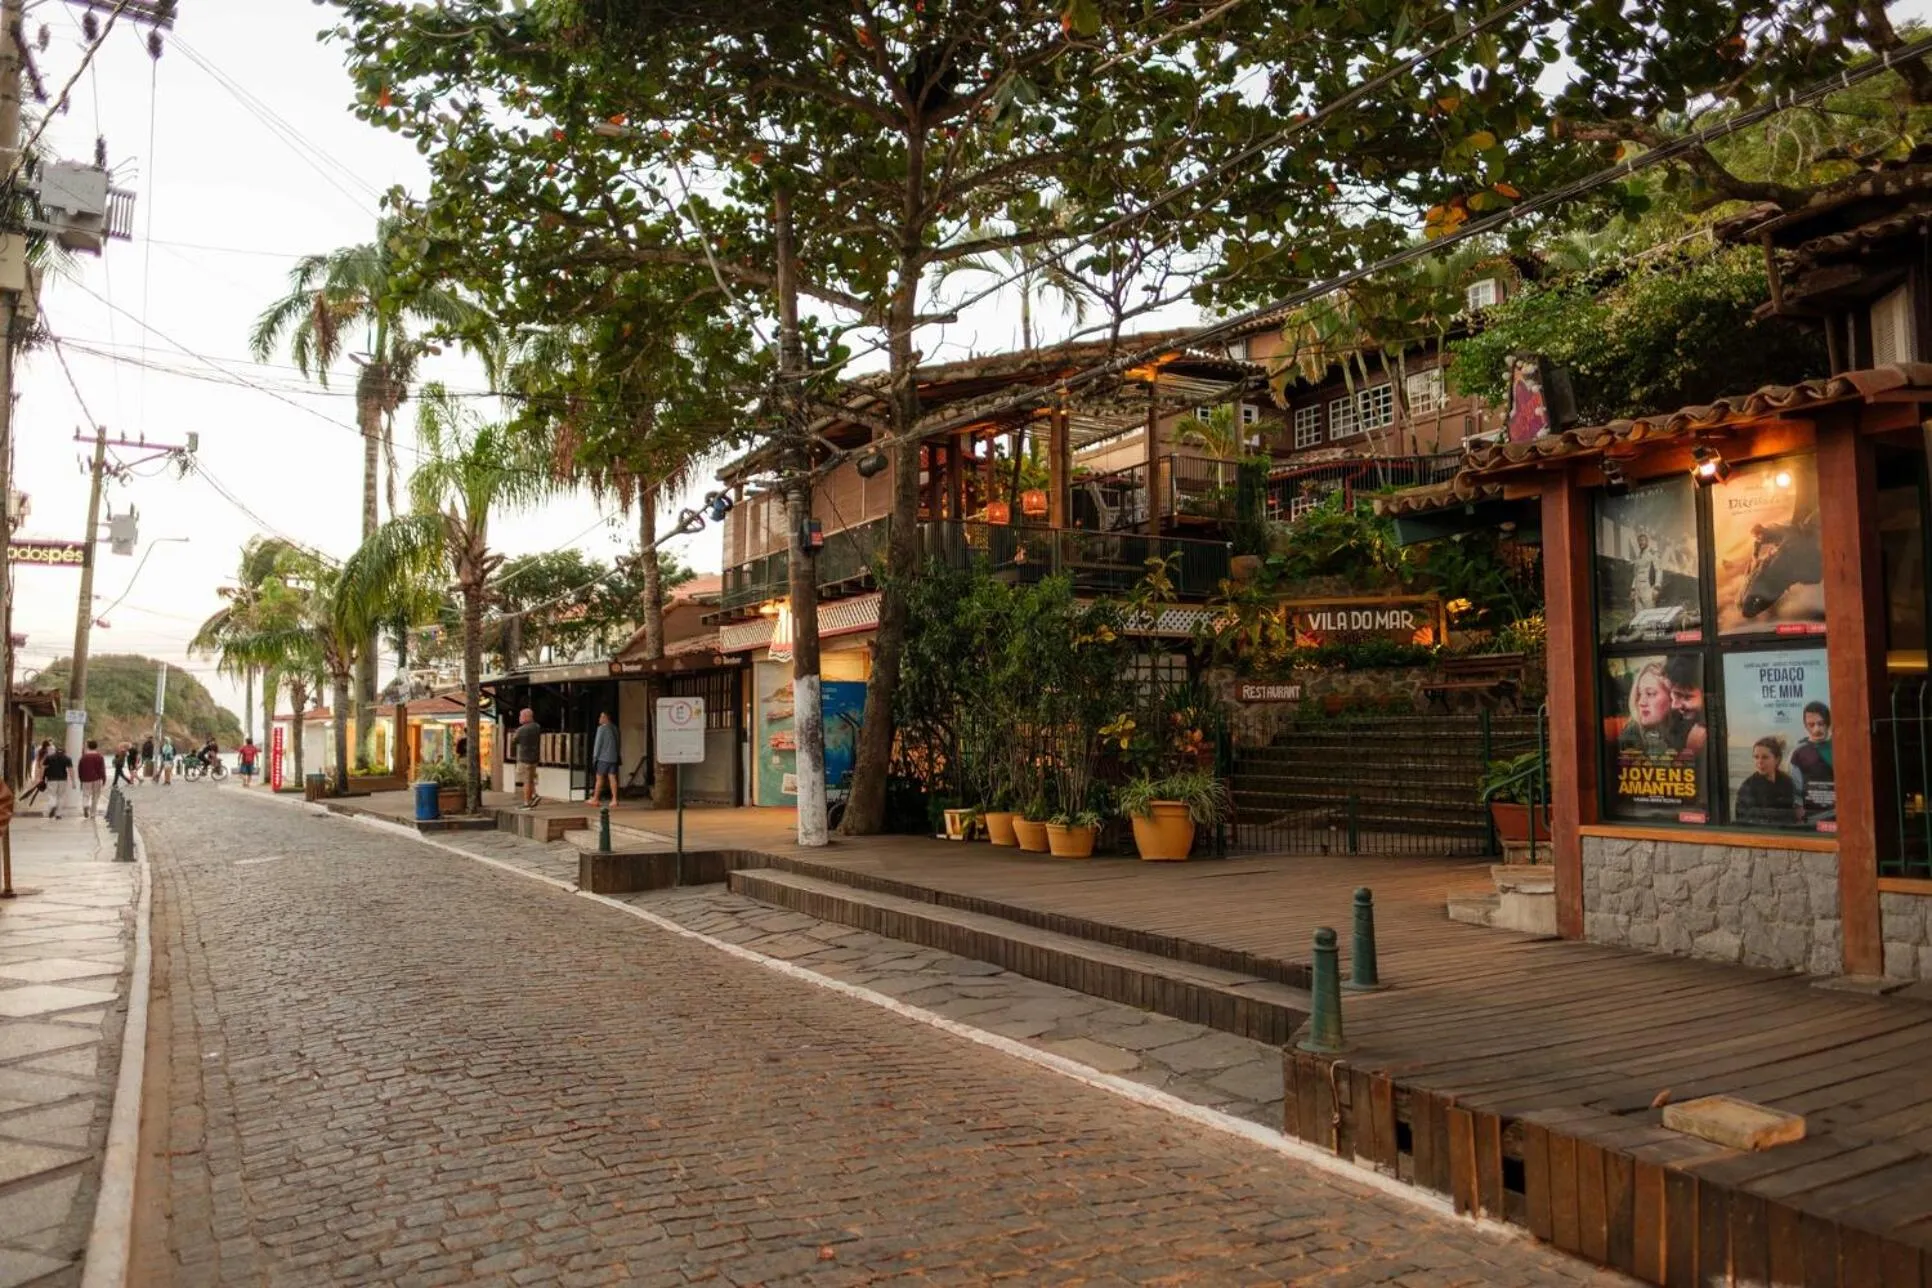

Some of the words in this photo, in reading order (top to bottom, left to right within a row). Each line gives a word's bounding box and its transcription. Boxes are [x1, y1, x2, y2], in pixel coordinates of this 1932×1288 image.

[1308, 612, 1347, 630] VILA
[1351, 611, 1373, 630] DO
[1375, 610, 1416, 630] MAR
[1759, 667, 1804, 683] PEDAÇO
[1242, 685, 1300, 699] RESTAURANT
[1762, 685, 1777, 699] DE
[1779, 684, 1804, 699] MIM
[1618, 767, 1696, 782] JOVENS
[1618, 781, 1697, 797] AMANTES
